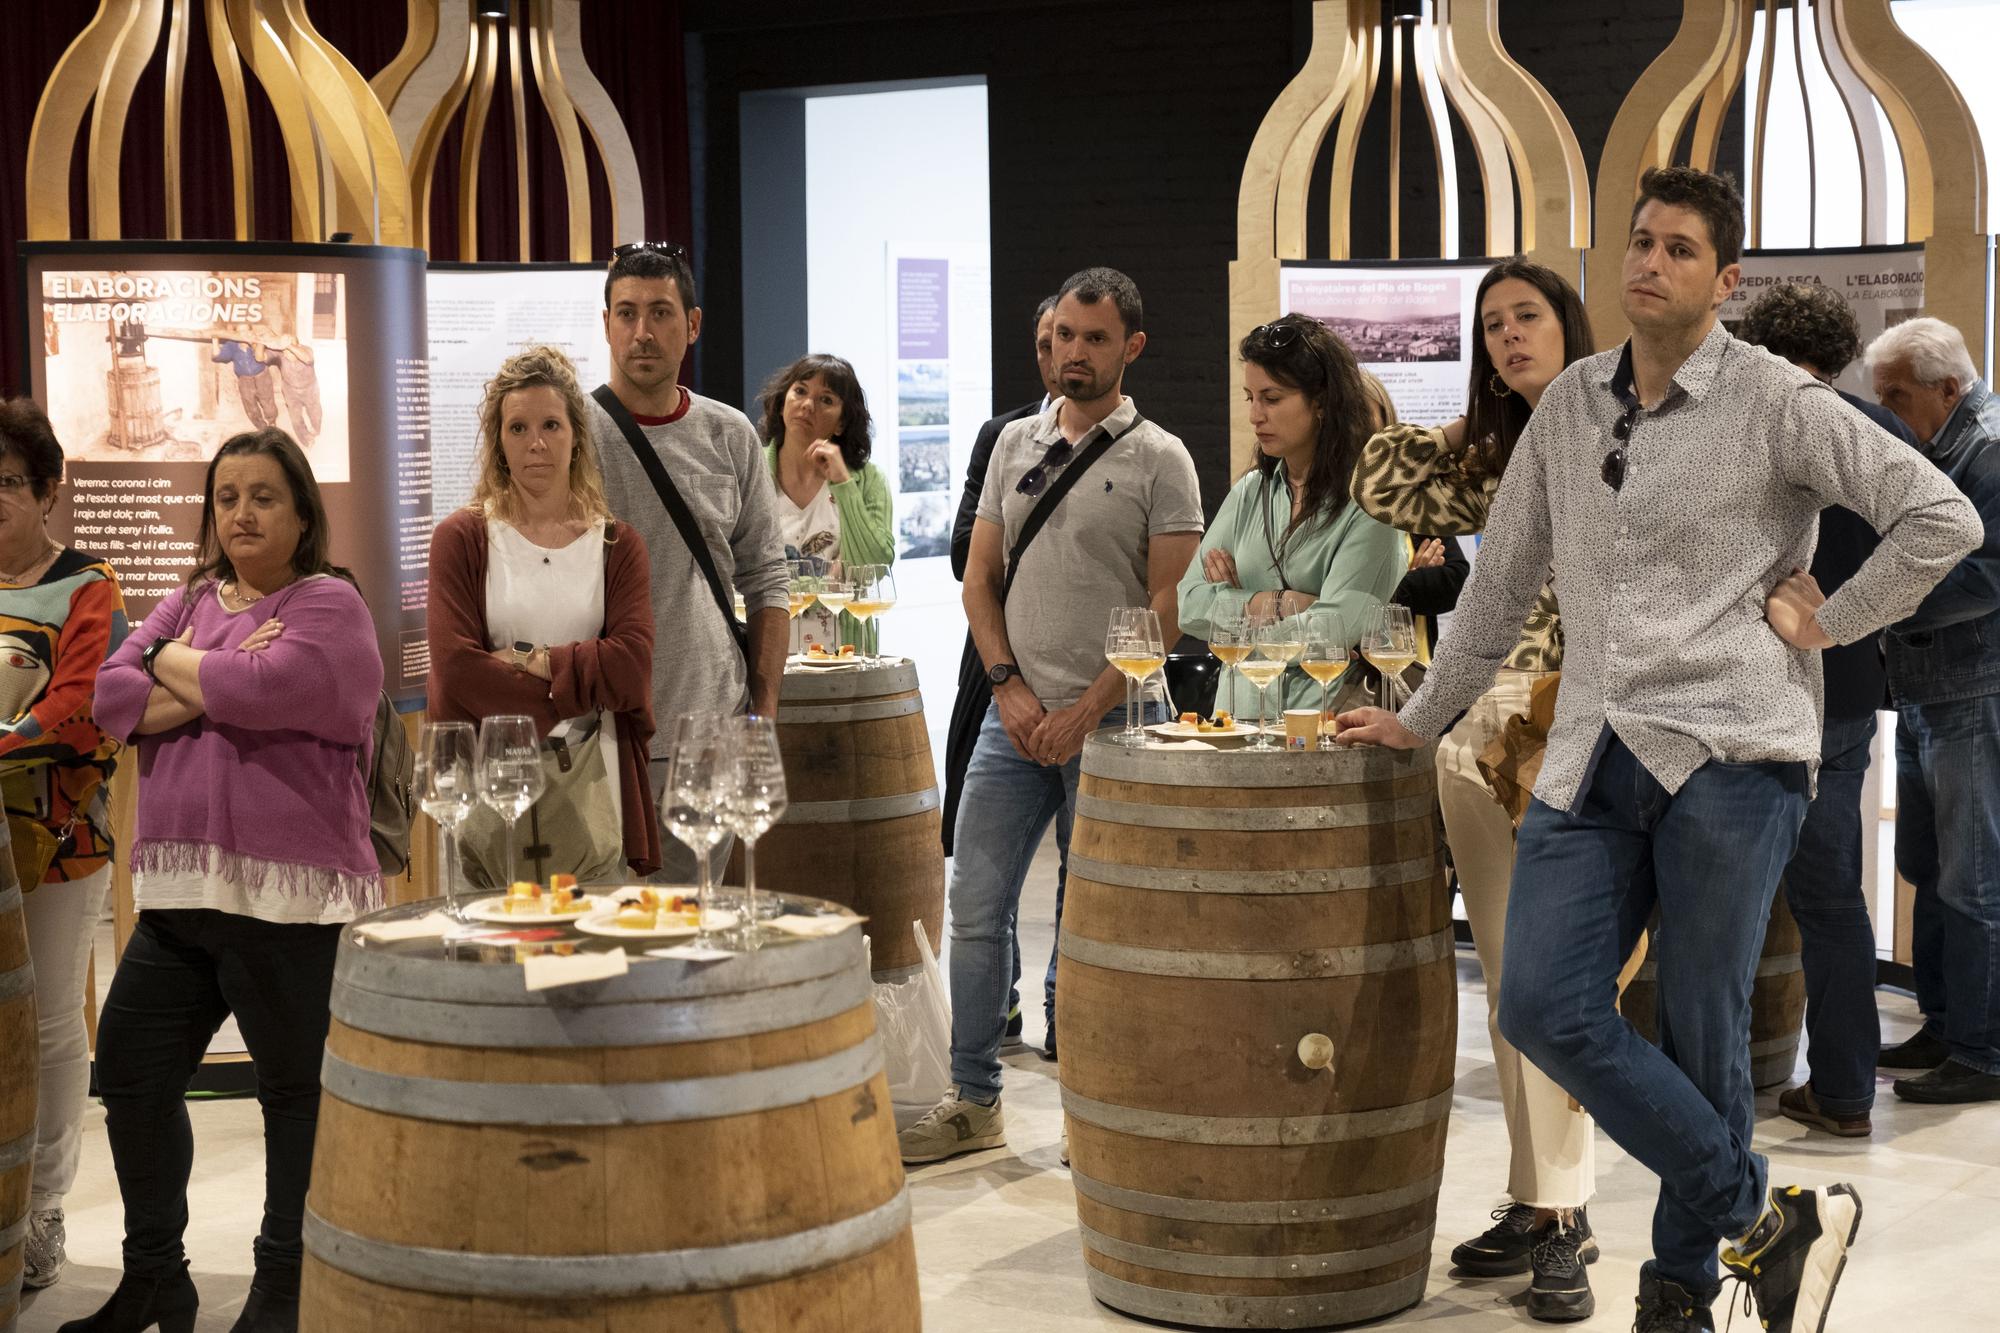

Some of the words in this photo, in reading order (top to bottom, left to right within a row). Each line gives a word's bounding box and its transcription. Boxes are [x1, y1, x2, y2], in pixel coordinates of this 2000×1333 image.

[52, 276, 262, 299] ELABORACIONS
[1358, 282, 1375, 294] del
[1377, 282, 1395, 293] Pla
[1397, 281, 1412, 293] de
[1414, 281, 1448, 294] Bages
[1738, 276, 1782, 288] PEDRA
[1846, 289, 1860, 299] LA
[52, 303, 263, 323] ELABORACIONES
[73, 478, 110, 488] Verema:
[111, 479, 146, 488] corona
[152, 477, 172, 488] cim
[72, 493, 85, 504] de
[86, 493, 118, 504] l'esclat
[119, 493, 135, 504] del
[135, 495, 161, 504] most
[163, 495, 184, 505] que
[184, 493, 205, 504] cria
[78, 509, 95, 520] raja
[97, 508, 112, 519] del
[113, 508, 134, 520] dolç
[74, 524, 102, 535] nèctar
[104, 524, 117, 534] de
[118, 526, 141, 536] seny
[74, 539, 88, 550] Els
[88, 541, 108, 550] teus
[109, 540, 125, 550] fills
[143, 541, 152, 550] vi
[157, 541, 168, 550] el
[110, 556, 132, 566] amb
[133, 555, 152, 566] èxit
[153, 557, 200, 566] ascende
[125, 573, 146, 581] mar
[147, 571, 180, 582] brava,
[120, 586, 145, 596] vibra
